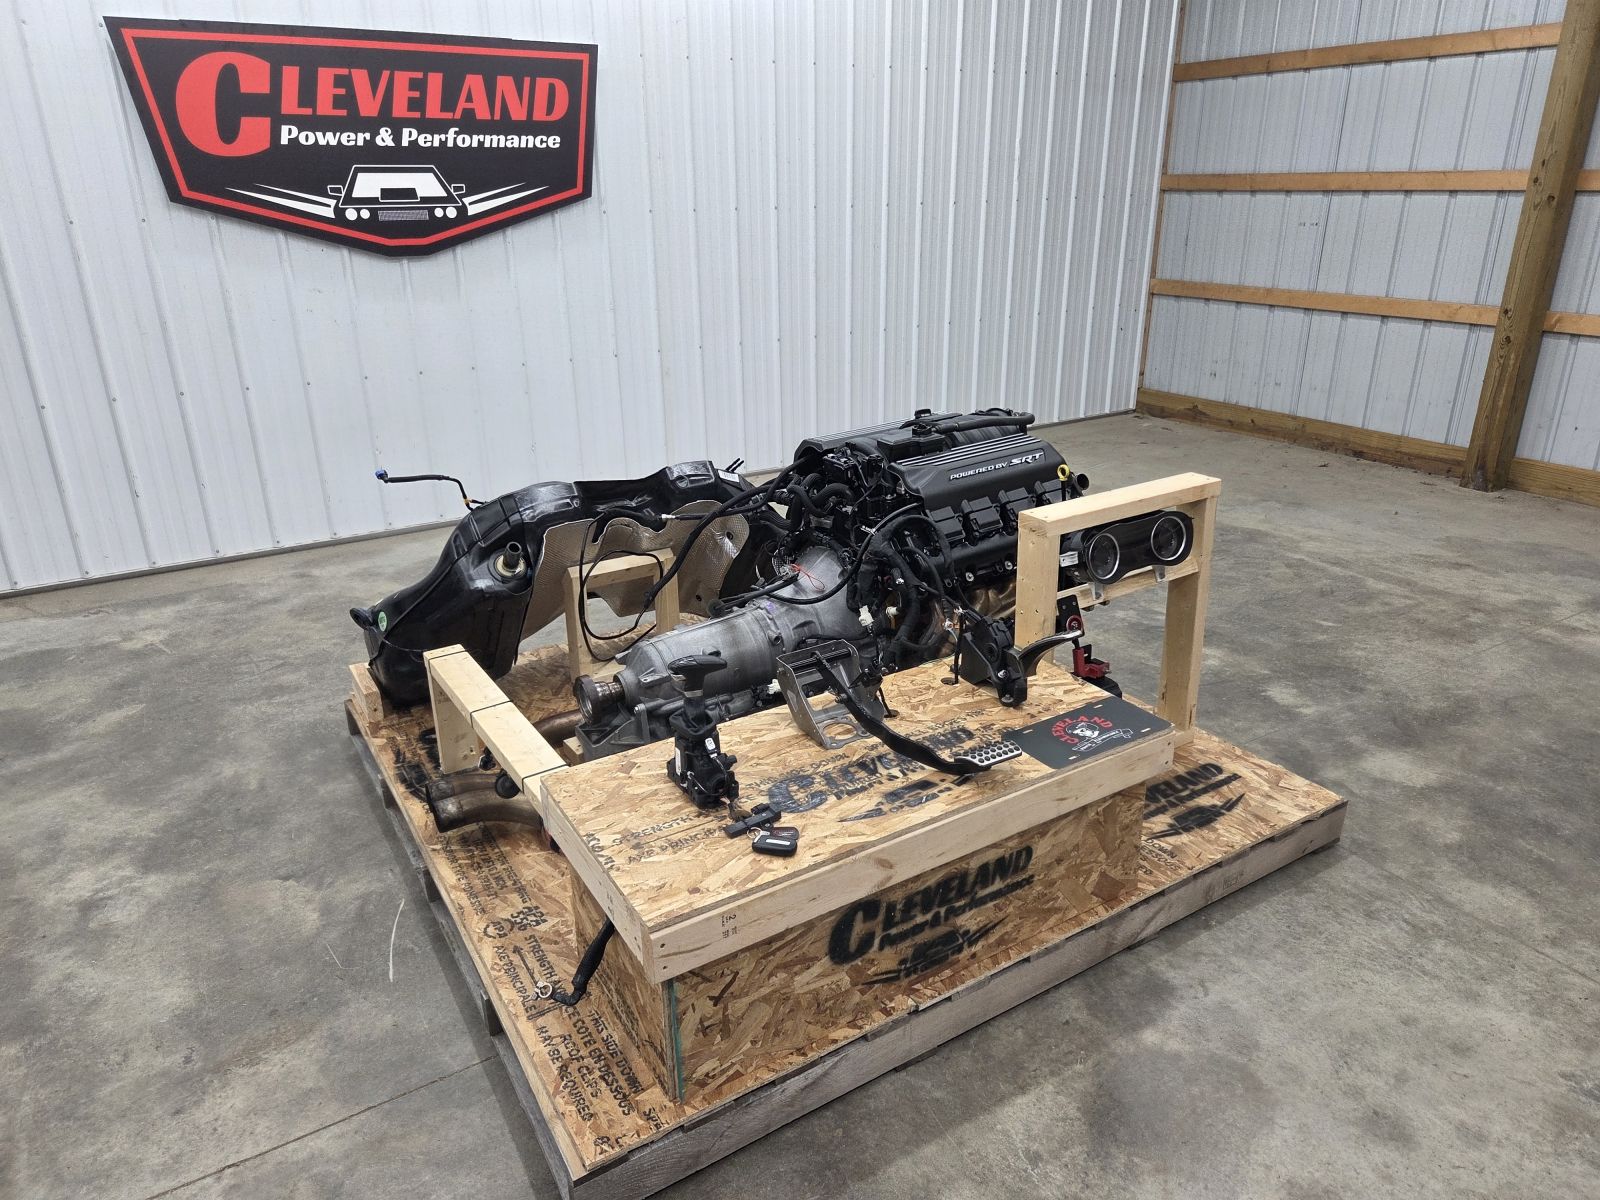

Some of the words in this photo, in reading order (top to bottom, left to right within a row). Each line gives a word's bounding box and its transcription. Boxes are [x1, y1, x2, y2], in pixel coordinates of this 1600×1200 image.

[176, 51, 569, 157] CLEVELAND
[280, 125, 371, 147] Power
[376, 127, 396, 147] &
[401, 127, 561, 149] Performance
[950, 465, 994, 480] POWERED
[995, 462, 1008, 470] BY
[1009, 452, 1044, 466] SRT
[1051, 715, 1113, 744] CLEVELAND
[828, 845, 1034, 966] CLEVELAND
[490, 919, 509, 939] APA
[492, 943, 510, 961] AXE
[523, 933, 557, 979] STRENGTH
[499, 961, 538, 1013] PRINCIPALE
[534, 1025, 557, 1050] MAY
[571, 1018, 597, 1048] COTE
[546, 1047, 564, 1064] BE
[557, 1032, 586, 1065] ROOF
[574, 1063, 605, 1099] CLIPS
[586, 1009, 608, 1033] THIS
[600, 1033, 623, 1058] SIDE
[614, 1057, 644, 1094] DOWN
[551, 1064, 597, 1123] REQUIRED
